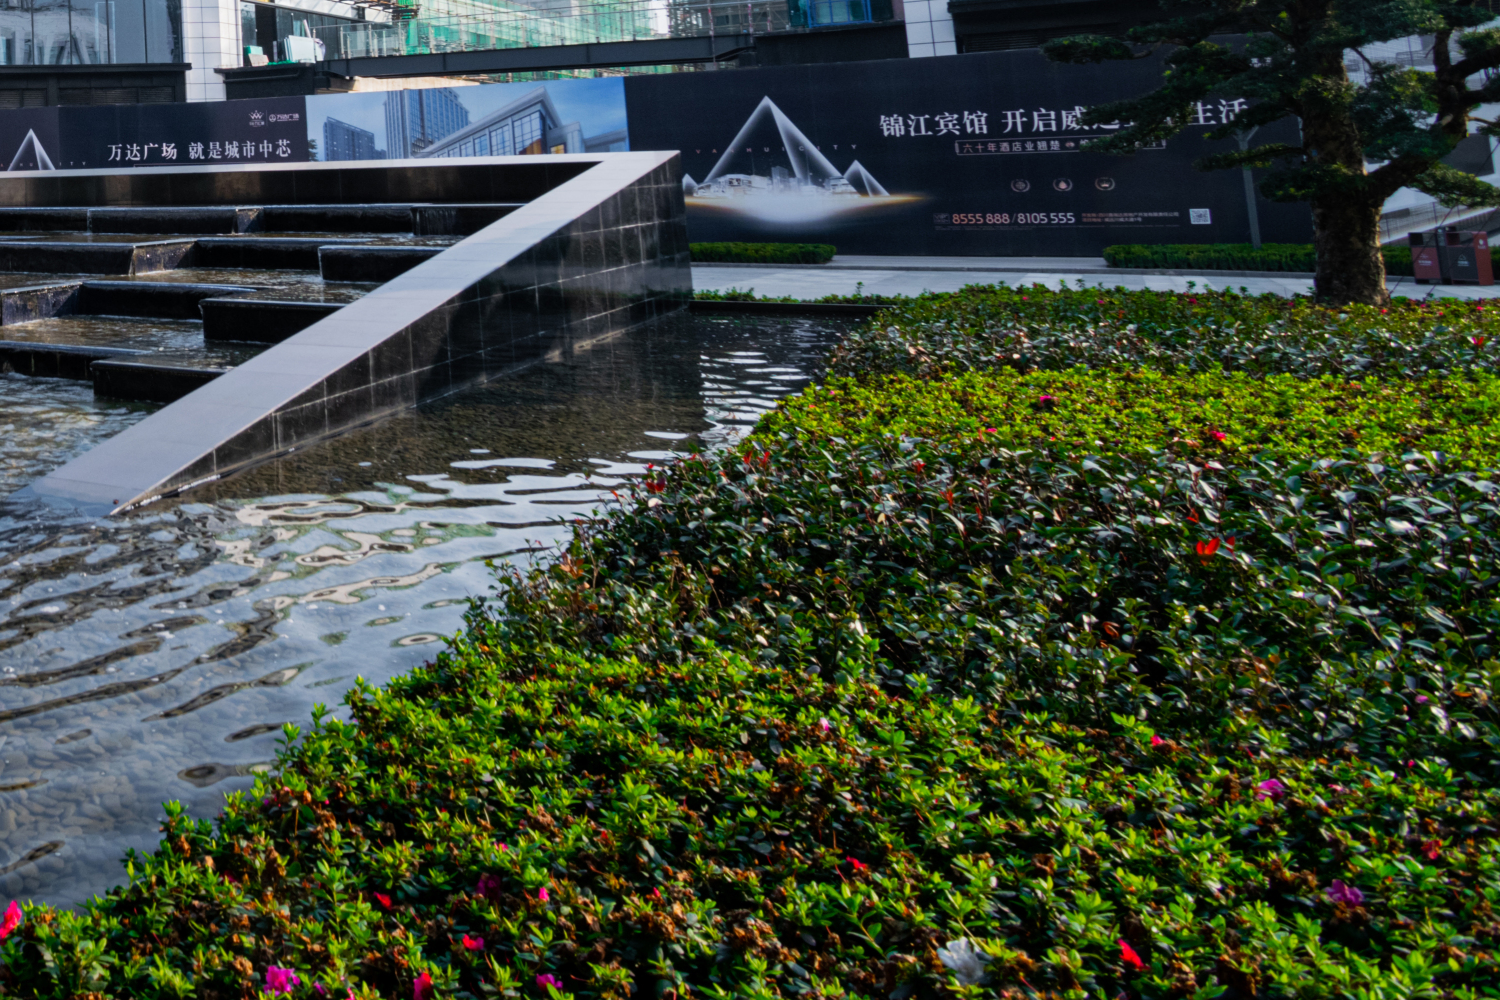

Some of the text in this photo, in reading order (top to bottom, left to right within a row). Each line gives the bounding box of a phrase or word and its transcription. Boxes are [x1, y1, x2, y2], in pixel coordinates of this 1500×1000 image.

[879, 110, 988, 137] 锦江宾馆
[107, 139, 291, 161] 万达广场 就是城市中芯
[963, 140, 1061, 153] 六十年酒店业翘楚
[952, 213, 984, 224] 8555
[986, 213, 1010, 224] 888
[1017, 213, 1048, 223] 8105
[1049, 212, 1076, 223] 555
